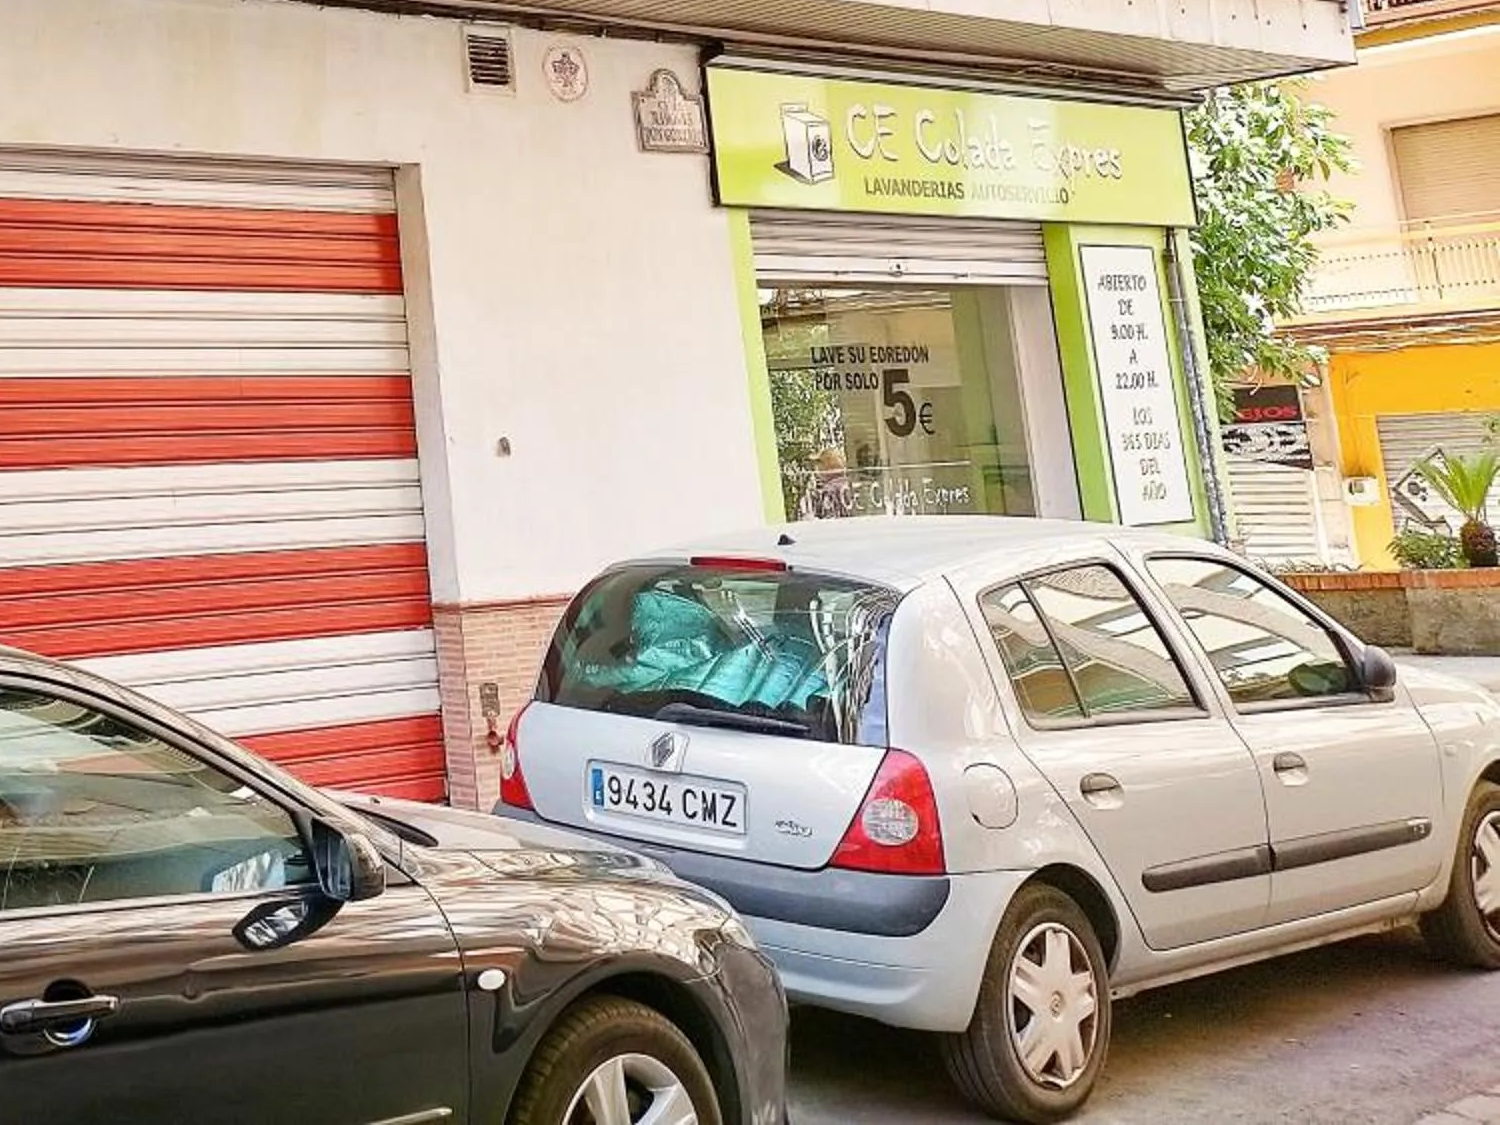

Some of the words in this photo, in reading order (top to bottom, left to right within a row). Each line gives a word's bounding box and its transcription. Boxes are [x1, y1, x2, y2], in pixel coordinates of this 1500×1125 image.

[846, 103, 900, 162] CE
[915, 107, 1016, 172] Colada
[1027, 118, 1123, 180] Expres
[864, 177, 965, 200] LAVANDERIAS
[970, 183, 1070, 205] AUTOSERVICIO
[1097, 274, 1147, 292] ABIERTO
[1118, 298, 1135, 316] DE
[810, 346, 845, 364] LAVE
[847, 346, 865, 364] SU
[1129, 348, 1139, 364] A
[815, 372, 842, 391] POR
[845, 372, 879, 390] SOLO
[607, 775, 673, 816] 9434
[682, 788, 737, 828] CMZ
